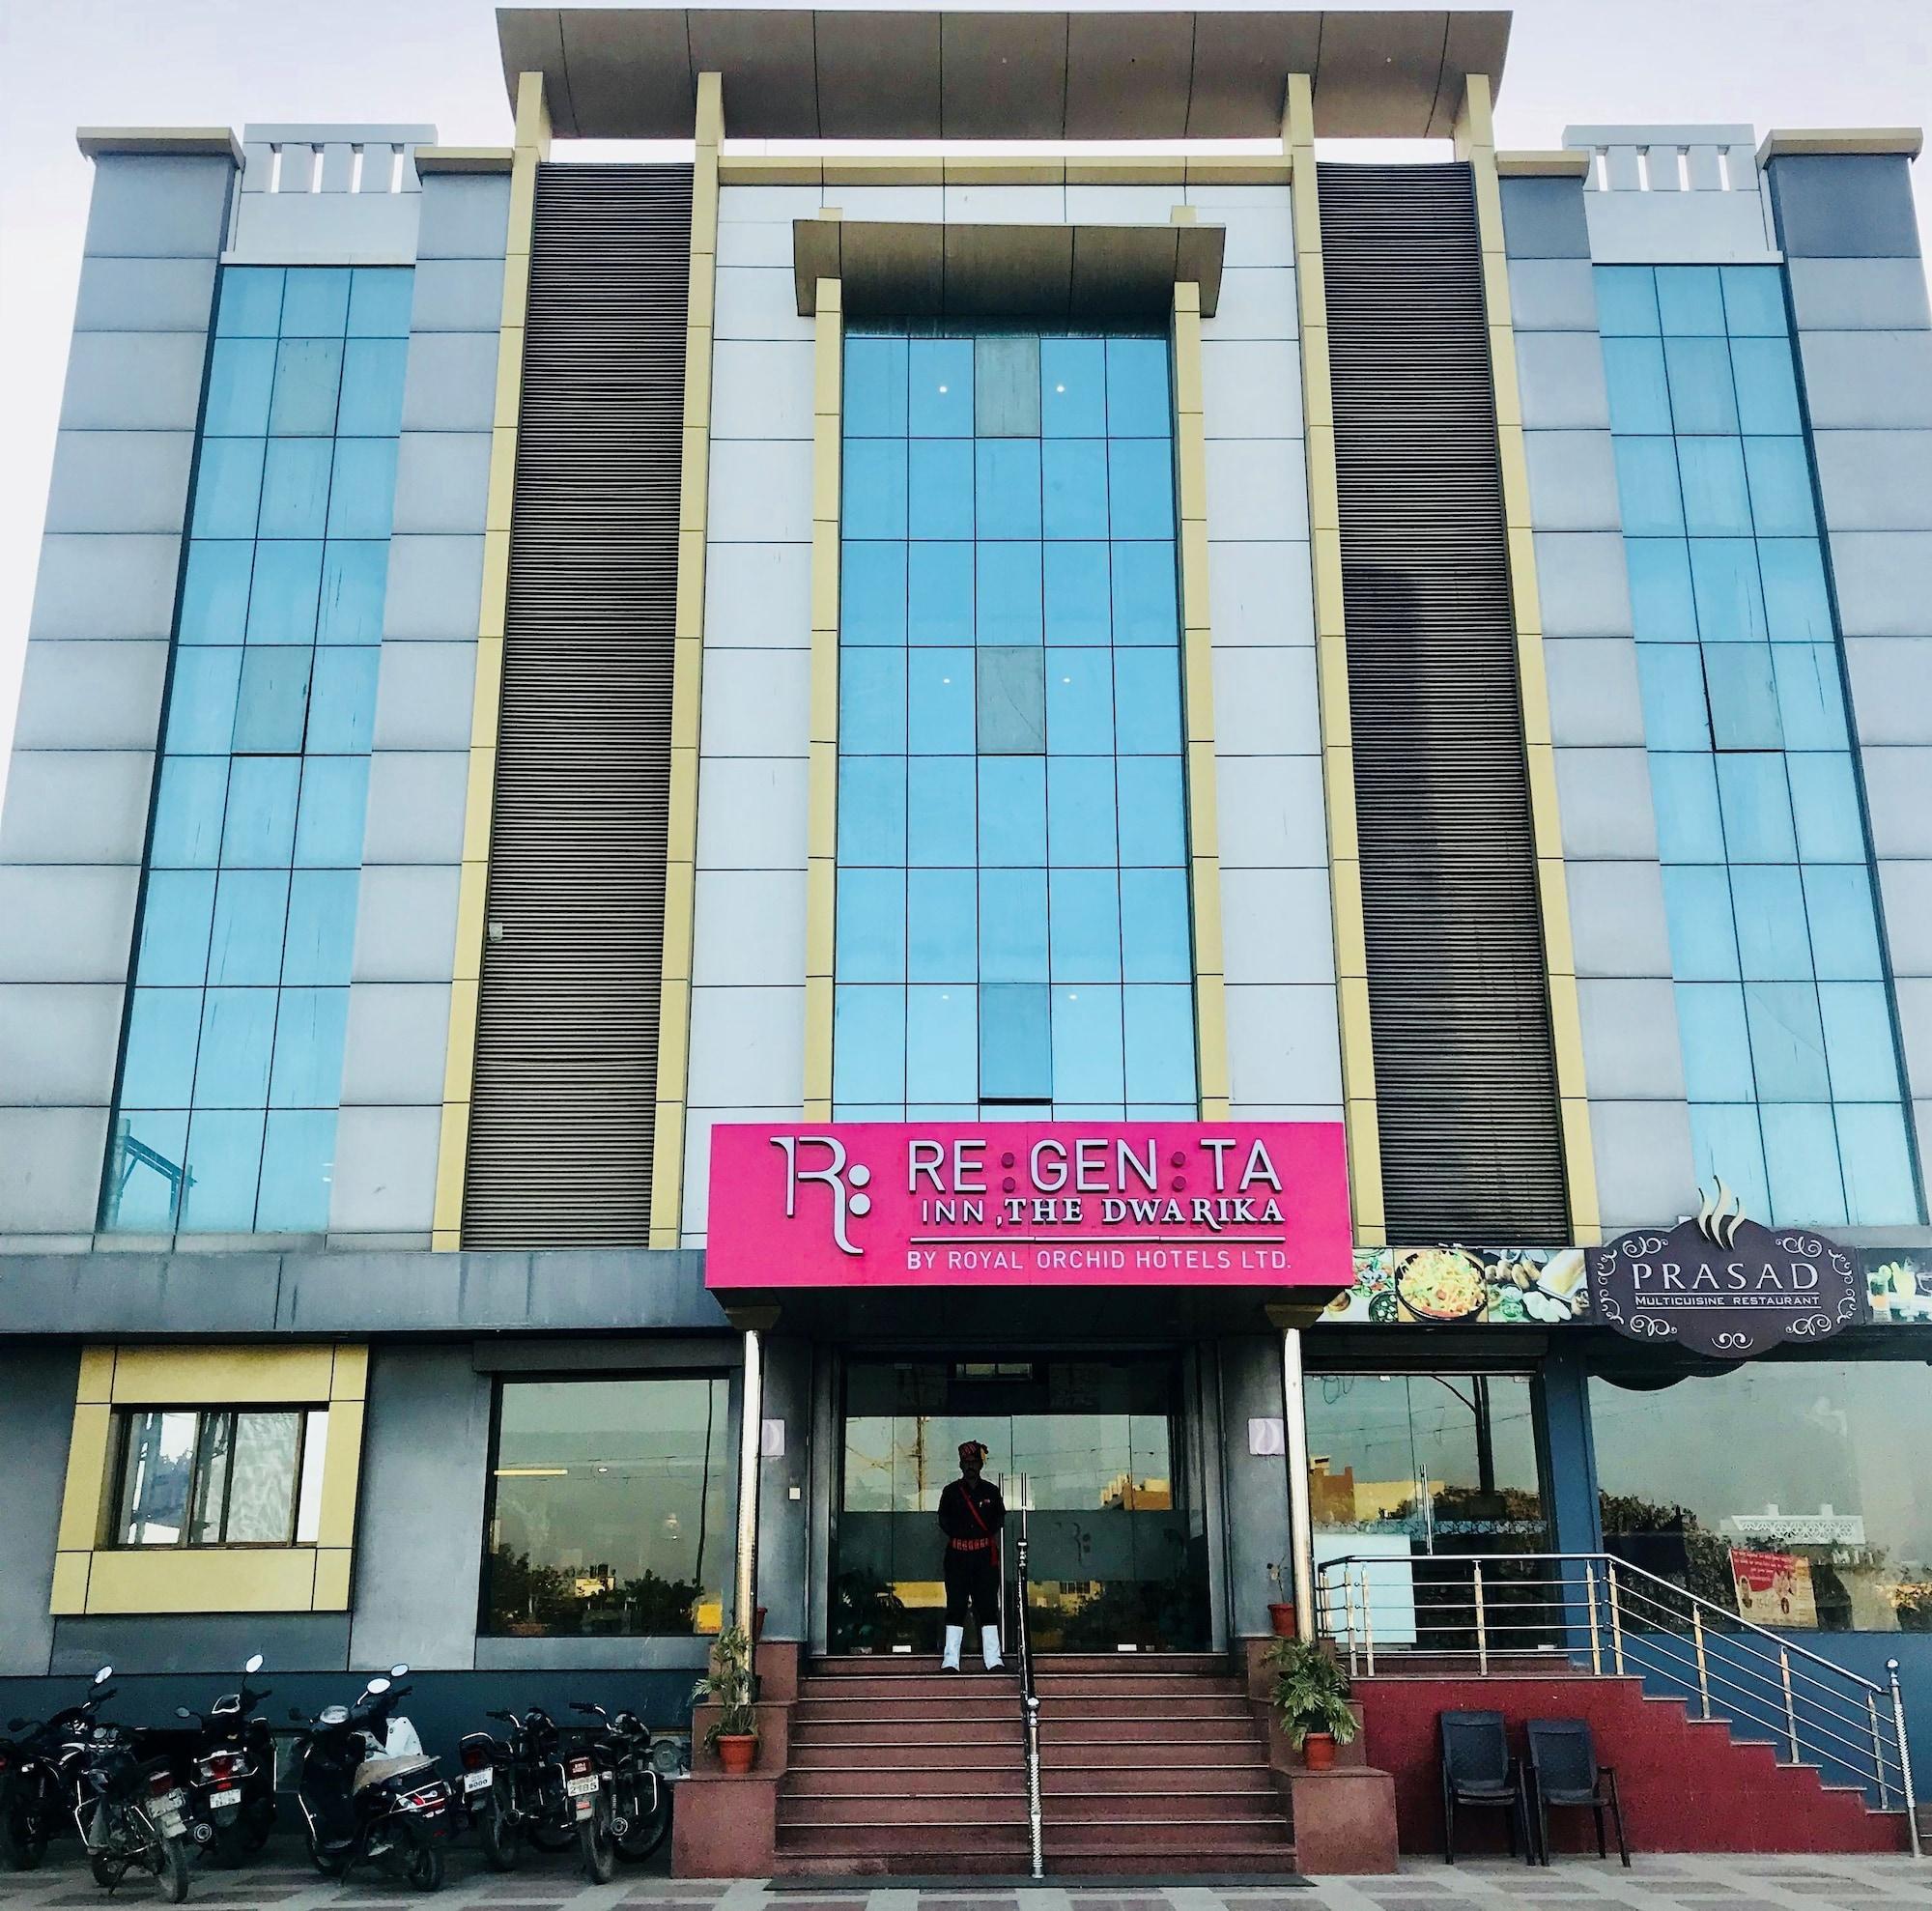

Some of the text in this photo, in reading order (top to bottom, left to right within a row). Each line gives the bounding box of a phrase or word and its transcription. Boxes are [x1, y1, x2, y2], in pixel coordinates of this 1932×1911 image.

[1102, 1198, 1286, 1230] DWARIKA
[907, 1250, 1292, 1269] BY ROYAL ORCHID HOTELS LTD.
[1632, 1263, 1819, 1290] PRASAD
[1635, 1296, 1820, 1306] MULTICUISINE RESTAURANT
